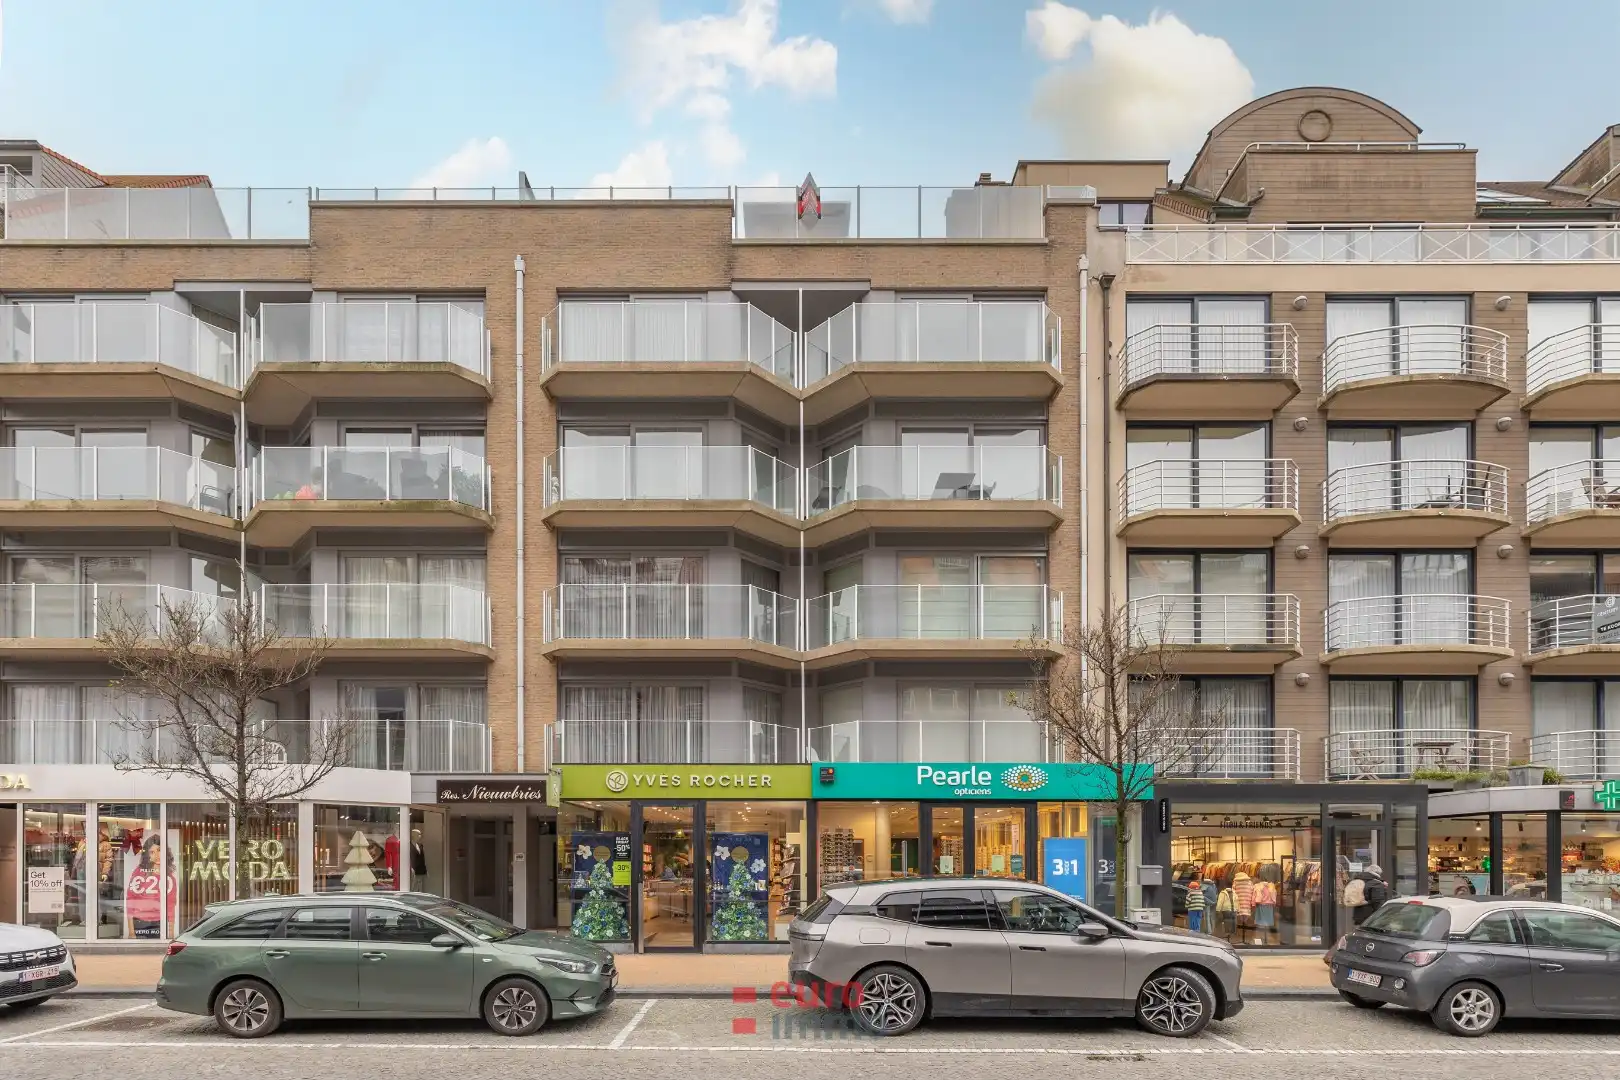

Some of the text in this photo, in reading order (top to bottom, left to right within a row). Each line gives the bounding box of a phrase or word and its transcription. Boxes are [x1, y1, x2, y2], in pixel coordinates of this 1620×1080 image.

[690, 774, 772, 788] ROCHER
[917, 765, 992, 786] Pearle
[440, 789, 460, 800] Res.
[954, 786, 992, 797] opticiens
[195, 839, 284, 860] VERO
[1053, 859, 1063, 875] 3
[1071, 859, 1077, 875] 1
[1098, 859, 1108, 873] 3
[30, 871, 46, 879] Get
[30, 879, 63, 888] 10% off
